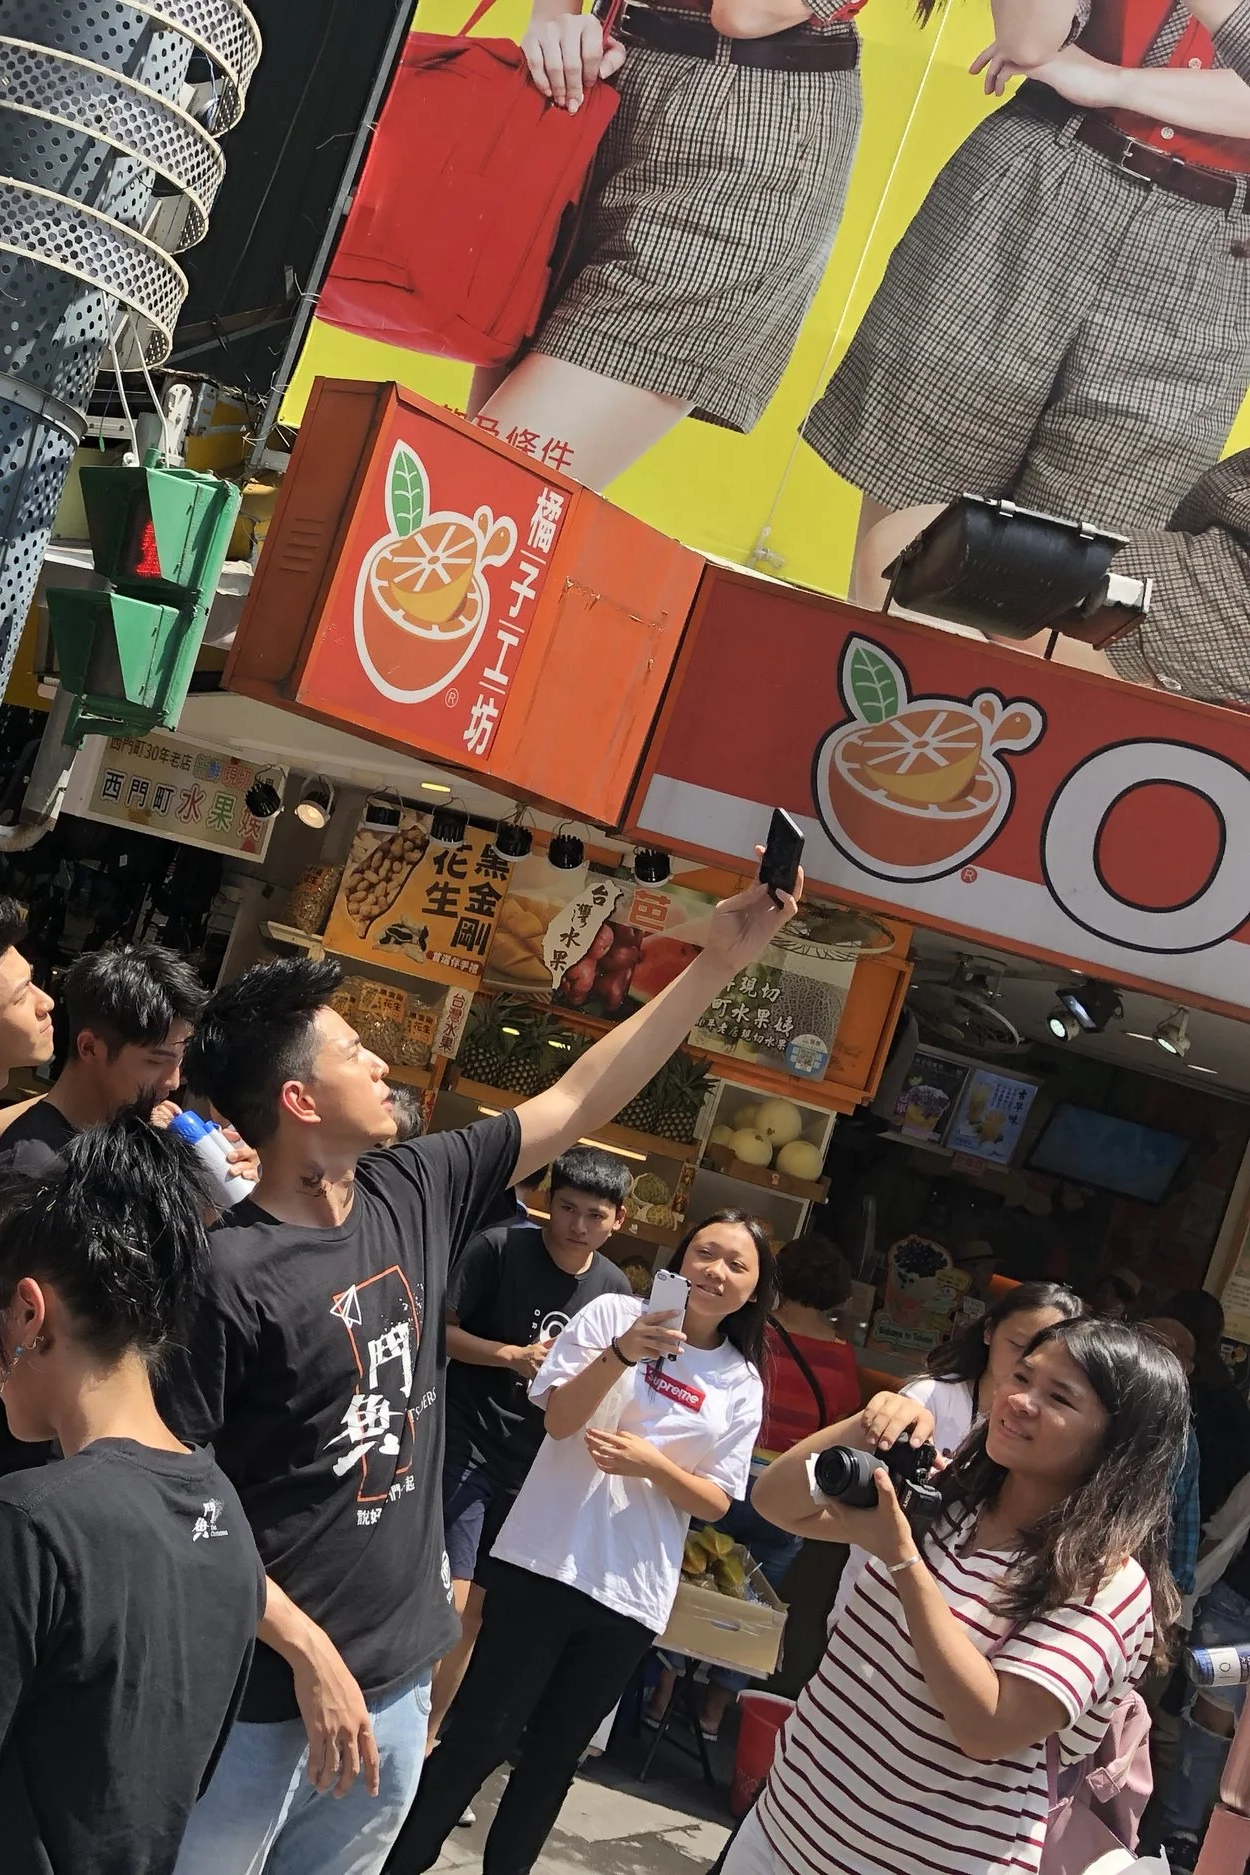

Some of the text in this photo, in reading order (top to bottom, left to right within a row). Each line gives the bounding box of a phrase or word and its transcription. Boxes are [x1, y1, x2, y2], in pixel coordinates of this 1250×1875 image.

[463, 486, 565, 756] 橘子工坊
[421, 843, 473, 920] 花生
[1041, 737, 1250, 956] O
[450, 842, 511, 957] 黑金剛
[550, 884, 610, 973] 台灣水果
[437, 992, 466, 1052] 台灣水果
